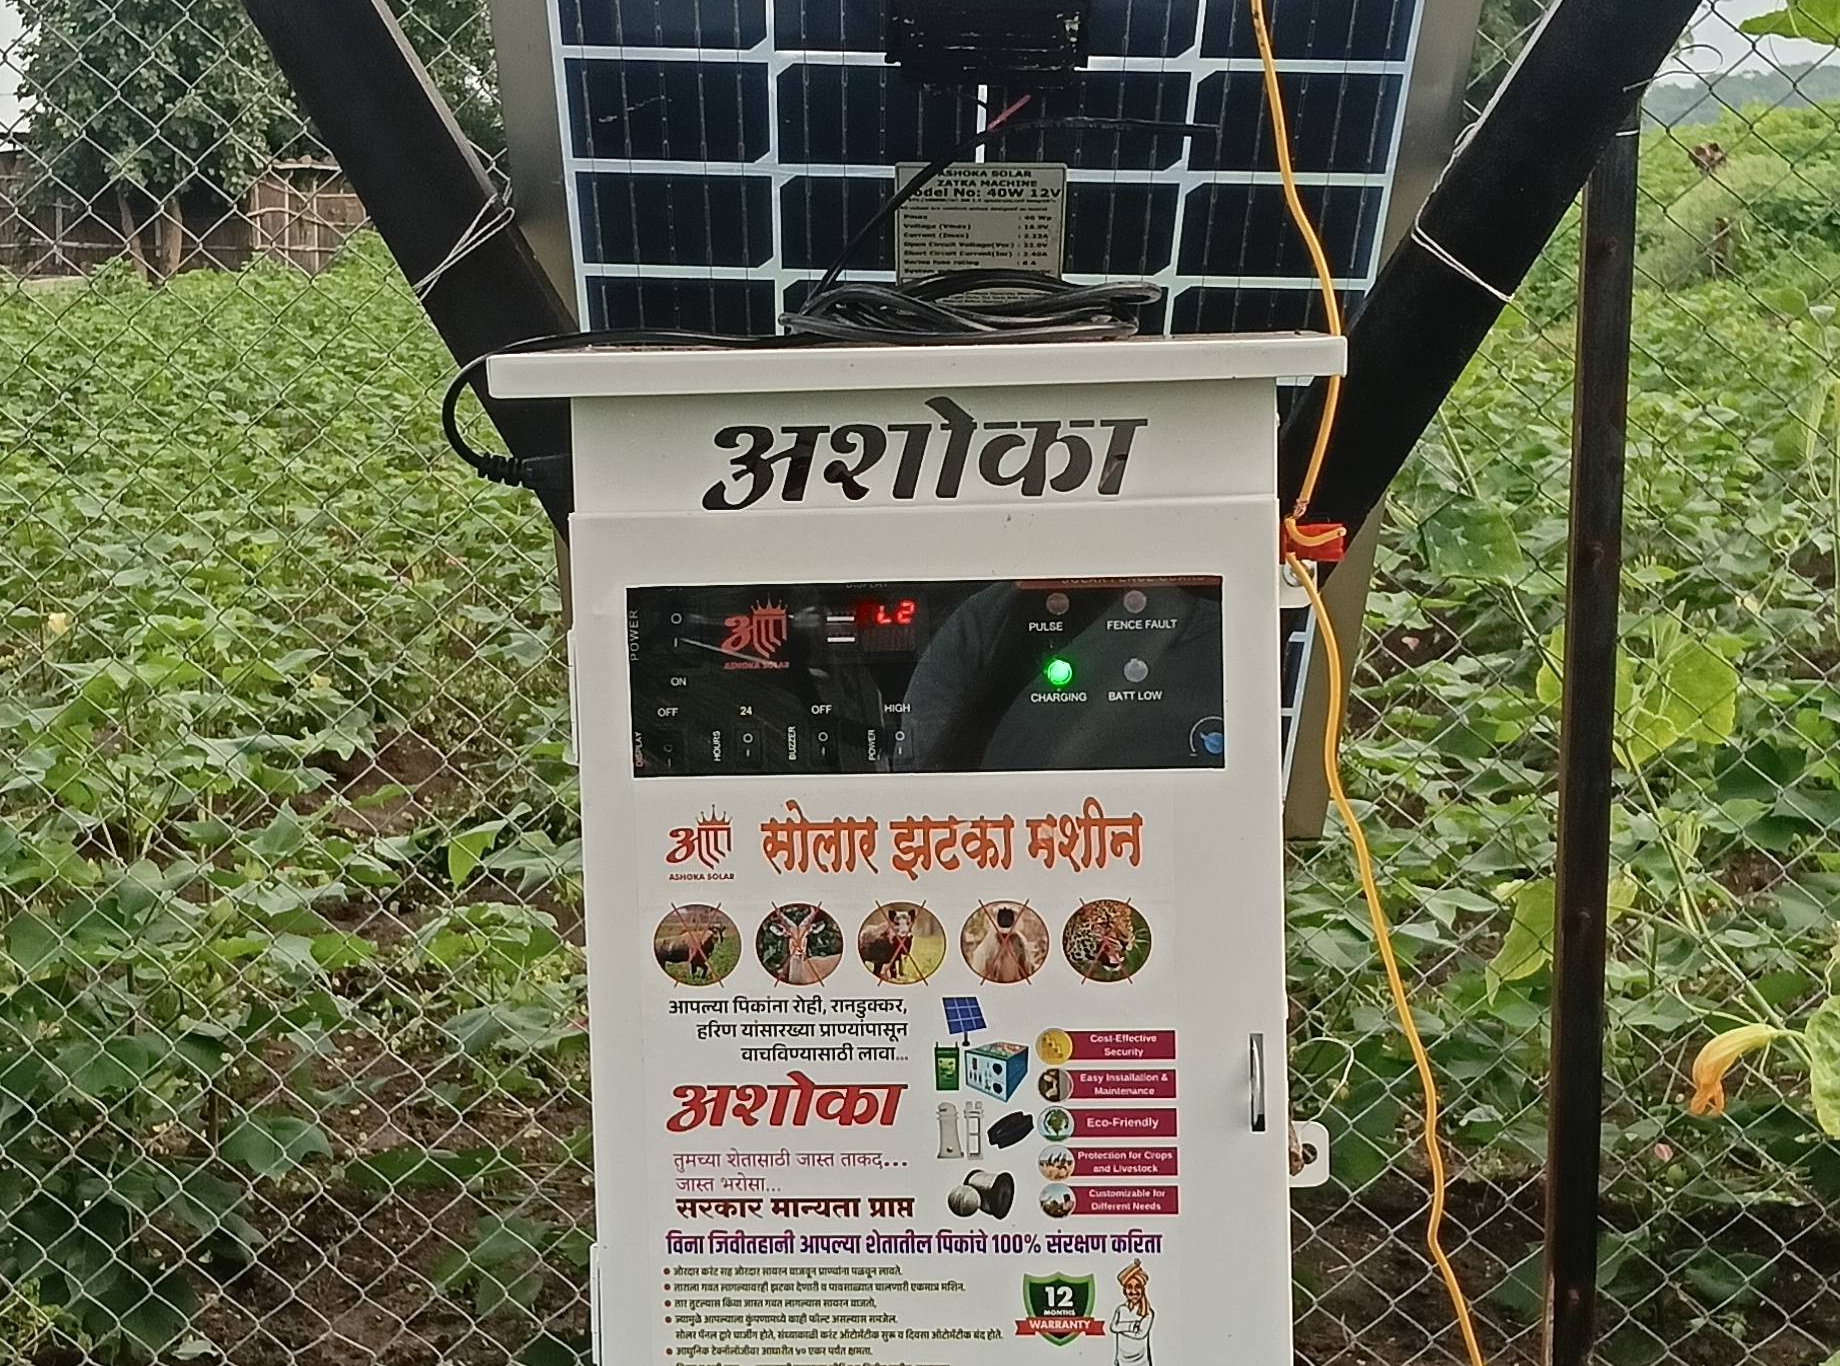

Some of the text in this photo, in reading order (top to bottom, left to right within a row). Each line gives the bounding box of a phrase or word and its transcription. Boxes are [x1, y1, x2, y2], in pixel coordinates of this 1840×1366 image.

[938, 170, 1032, 178] ASHOKA SOLAR
[937, 179, 1037, 188] ZATKA MACHINE
[912, 187, 1061, 198] odel No: 40W 12V
[702, 396, 1149, 511] अशोका
[1029, 621, 1064, 632] PULSE
[1106, 619, 1178, 631] FENCE FAULT
[629, 609, 641, 661] POWER
[670, 677, 687, 687] ON
[1030, 692, 1088, 704] CHARGING
[1108, 691, 1163, 702] BATT LOW
[657, 707, 679, 718] OFF
[739, 706, 753, 716] 24
[811, 704, 833, 715] OFF
[884, 703, 912, 714] HIGH
[713, 730, 721, 762] HOURS
[788, 726, 797, 761] BUZZER
[868, 729, 877, 761] POWER
[635, 731, 644, 768] DISPLAY
[760, 796, 1143, 882] सोलार झटका मशीन
[669, 873, 735, 881] ASHOKA SOLAR
[669, 994, 908, 1019] आपल्या पिकांना रोही, रानडुक्कर,
[697, 1018, 908, 1042] हरिण यांसारख्या प्राण्यांपासून
[1089, 1033, 1157, 1043] Cost-Effective
[741, 1042, 853, 1062] वाचविण्यासाठी
[1104, 1047, 1144, 1057] Security
[1080, 1073, 1169, 1084] Easy Installation &
[1094, 1087, 1155, 1096] Maintenance
[666, 1070, 909, 1132] अशोका
[1086, 1117, 1160, 1130] Eco-Friendly
[673, 1152, 721, 1173] तुमच्या
[726, 1147, 790, 1169] शेतासाठी
[796, 1152, 836, 1168] जास्त
[1078, 1151, 1173, 1161] Protection for Crops
[1093, 1164, 1158, 1173] and Livestock
[676, 1177, 714, 1192] जास्त
[1088, 1188, 1166, 1198] Customizable for
[675, 1197, 916, 1220] सरकार मान्यता प्राप्त
[1091, 1202, 1161, 1211] Different Needs
[666, 1228, 1163, 1255] विना जिवीतहानी आपल्या शेतातील पिकांचे 100% संरक्षण करिता
[1044, 1286, 1074, 1308] 12
[1043, 1309, 1076, 1317] MONTHS
[1029, 1319, 1091, 1330] WARRANTY
